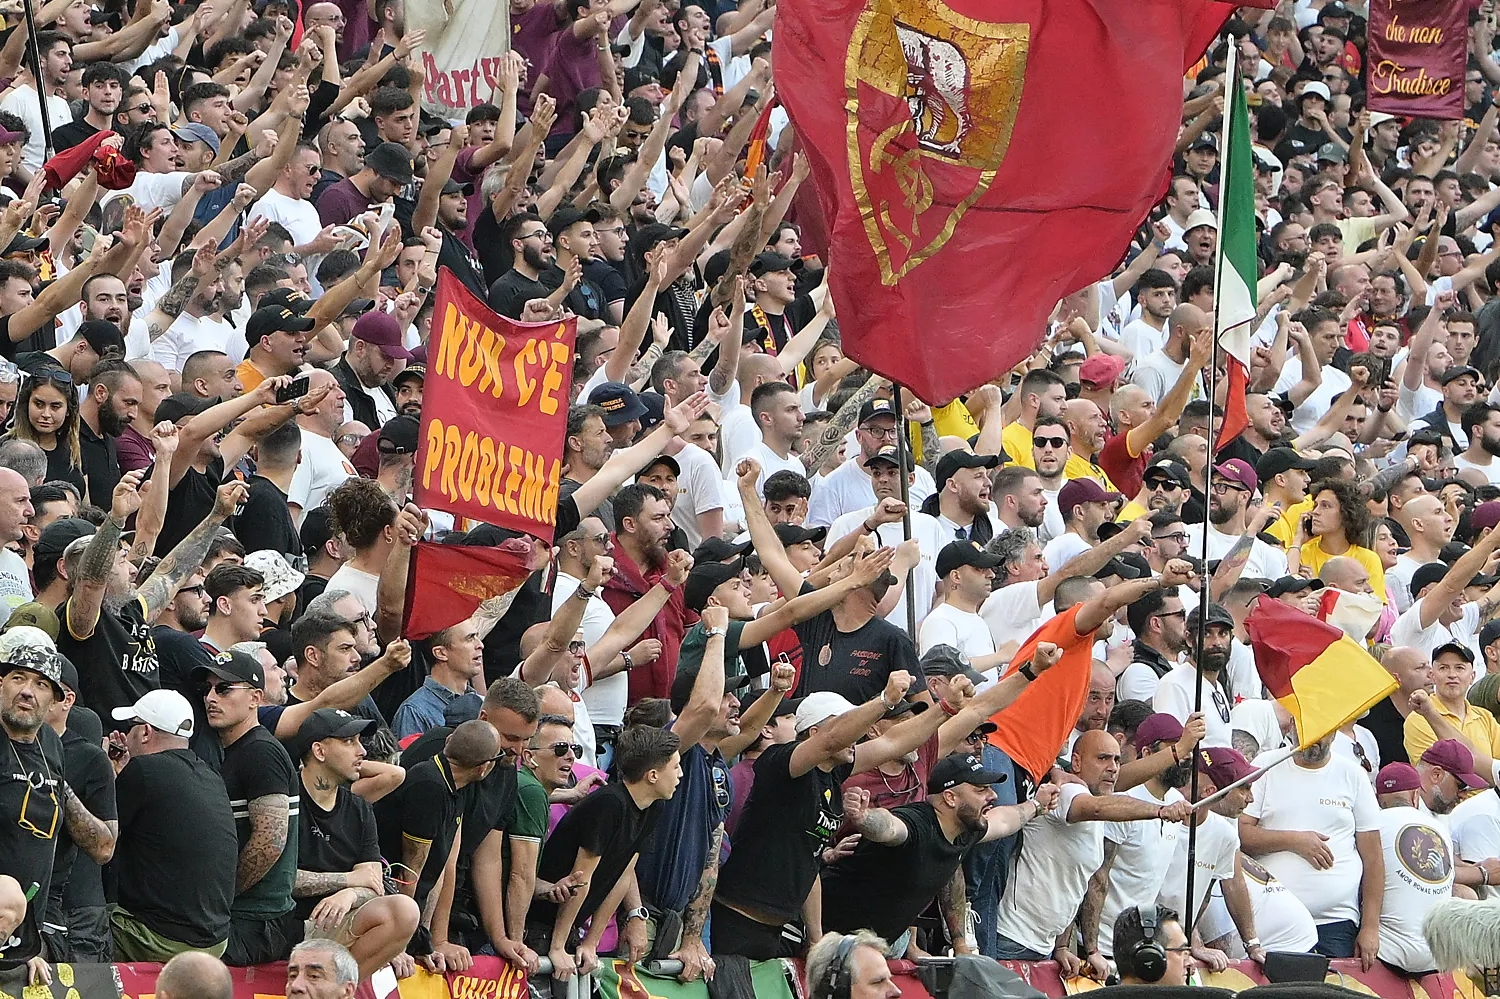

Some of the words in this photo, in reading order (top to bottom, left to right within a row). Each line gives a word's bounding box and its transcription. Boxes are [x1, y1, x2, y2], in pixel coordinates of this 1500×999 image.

[1385, 14, 1406, 43] che
[1408, 25, 1443, 44] non
[421, 51, 500, 110] Party
[1371, 59, 1451, 96] Tradisce
[513, 323, 570, 416] C'È
[422, 418, 562, 527] PROBLEMA
[849, 650, 883, 661] PASSIONE
[1319, 798, 1342, 807] ROMA
[1395, 868, 1414, 886] AMOR
[452, 963, 525, 999] quelli
